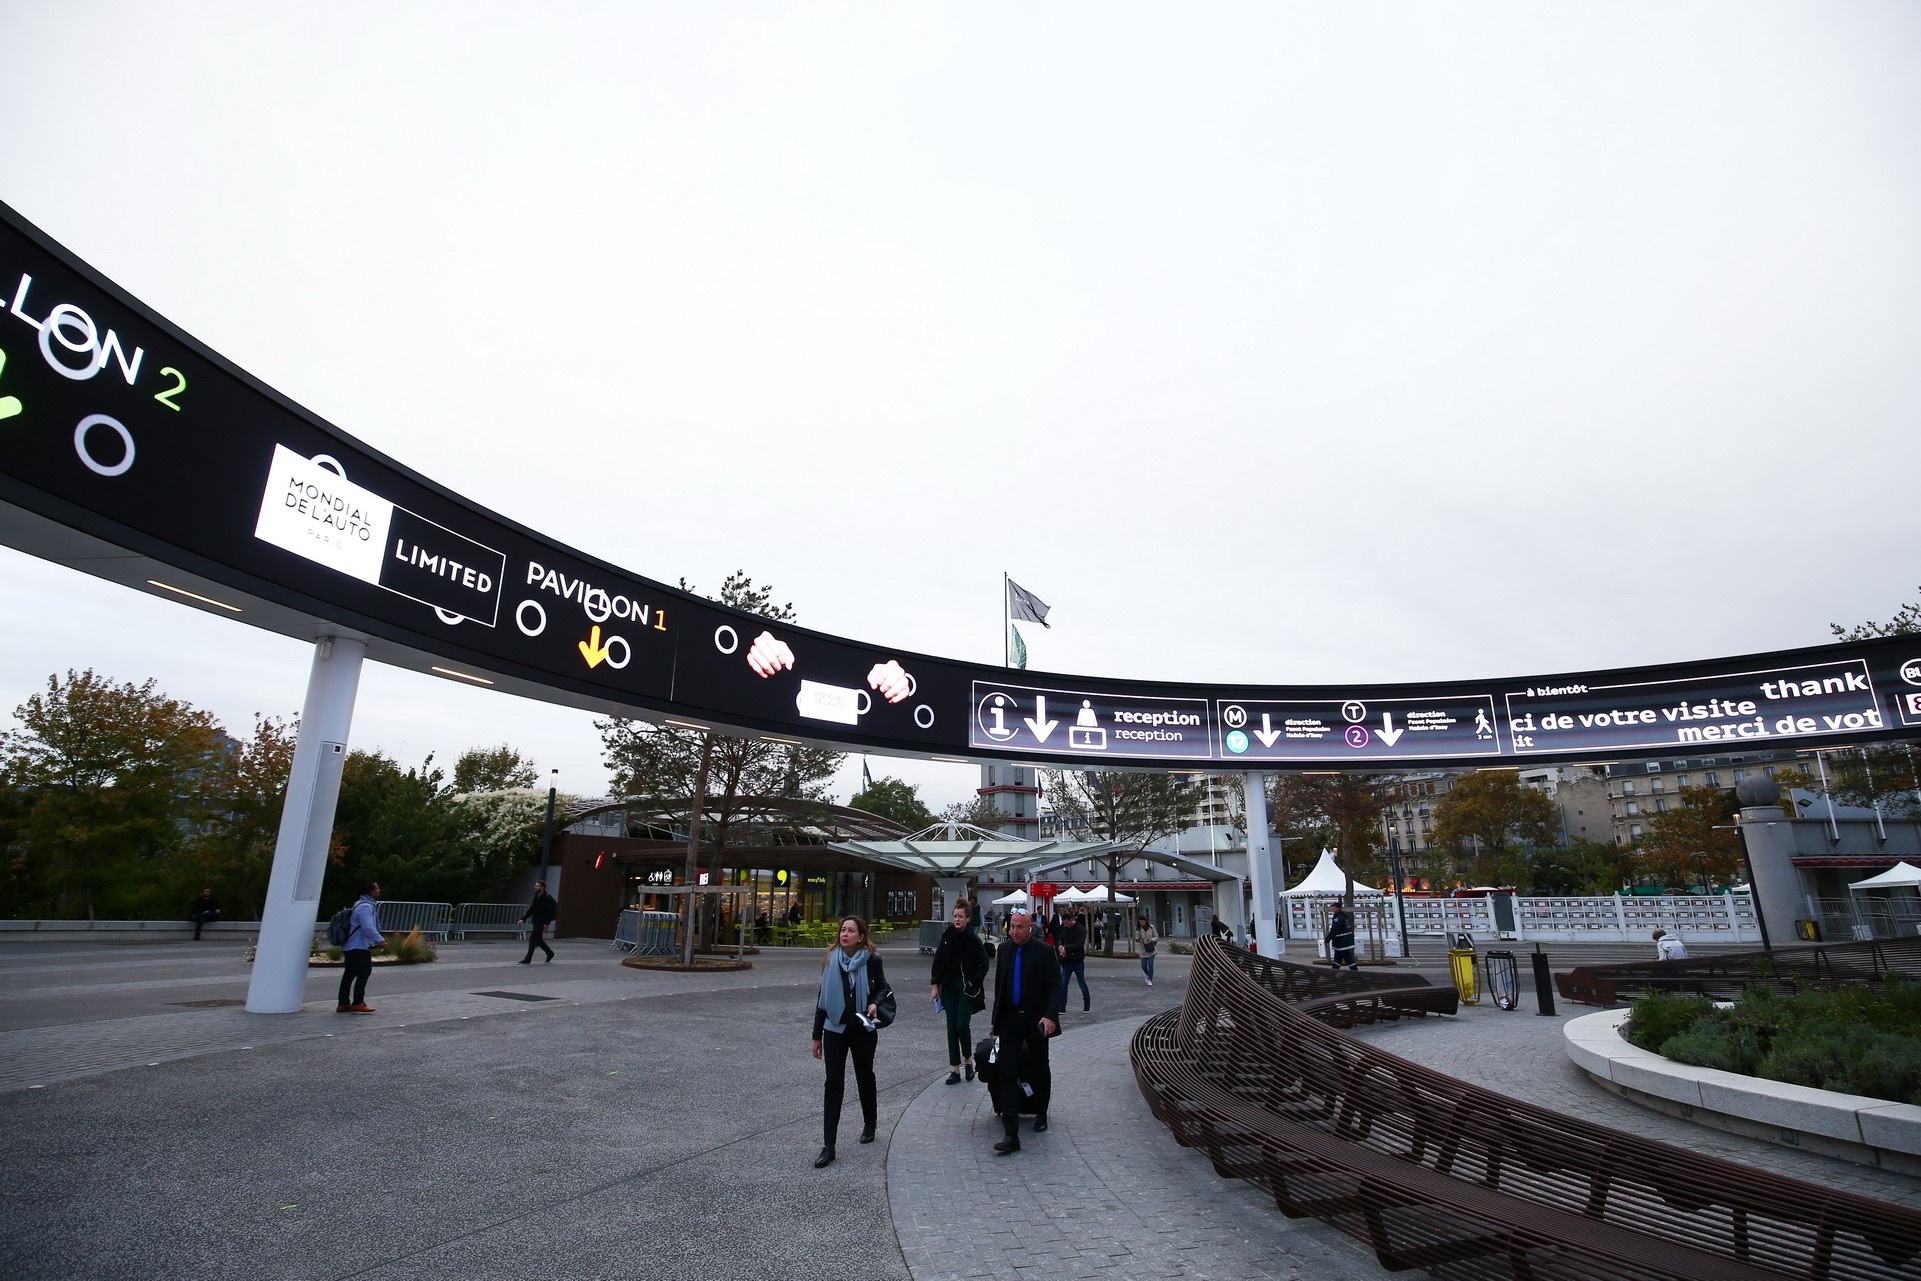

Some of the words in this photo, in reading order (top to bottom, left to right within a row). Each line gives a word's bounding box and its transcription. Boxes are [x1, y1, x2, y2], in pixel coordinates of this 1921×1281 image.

[0, 273, 144, 386] LON
[154, 366, 186, 411] 2
[285, 492, 308, 515] DE
[289, 477, 371, 526] MONDIAL
[395, 538, 492, 593] LIMITED
[526, 561, 649, 626] PAVILLON
[654, 610, 667, 631] 1
[1526, 687, 1535, 697] à
[1537, 684, 1589, 697] bientôt
[1760, 672, 1869, 700] thank
[1113, 710, 1200, 727] reception
[1229, 710, 1243, 723] M
[1347, 706, 1360, 719] T
[1406, 711, 1446, 719] direction
[1541, 713, 1574, 730] de
[1578, 709, 1657, 728] votre
[1661, 698, 1757, 722] visite
[1115, 729, 1183, 742] reception
[1351, 729, 1362, 743] 2
[1677, 716, 1770, 742] merci
[1775, 715, 1817, 734] de
[1229, 735, 1246, 749] 12
